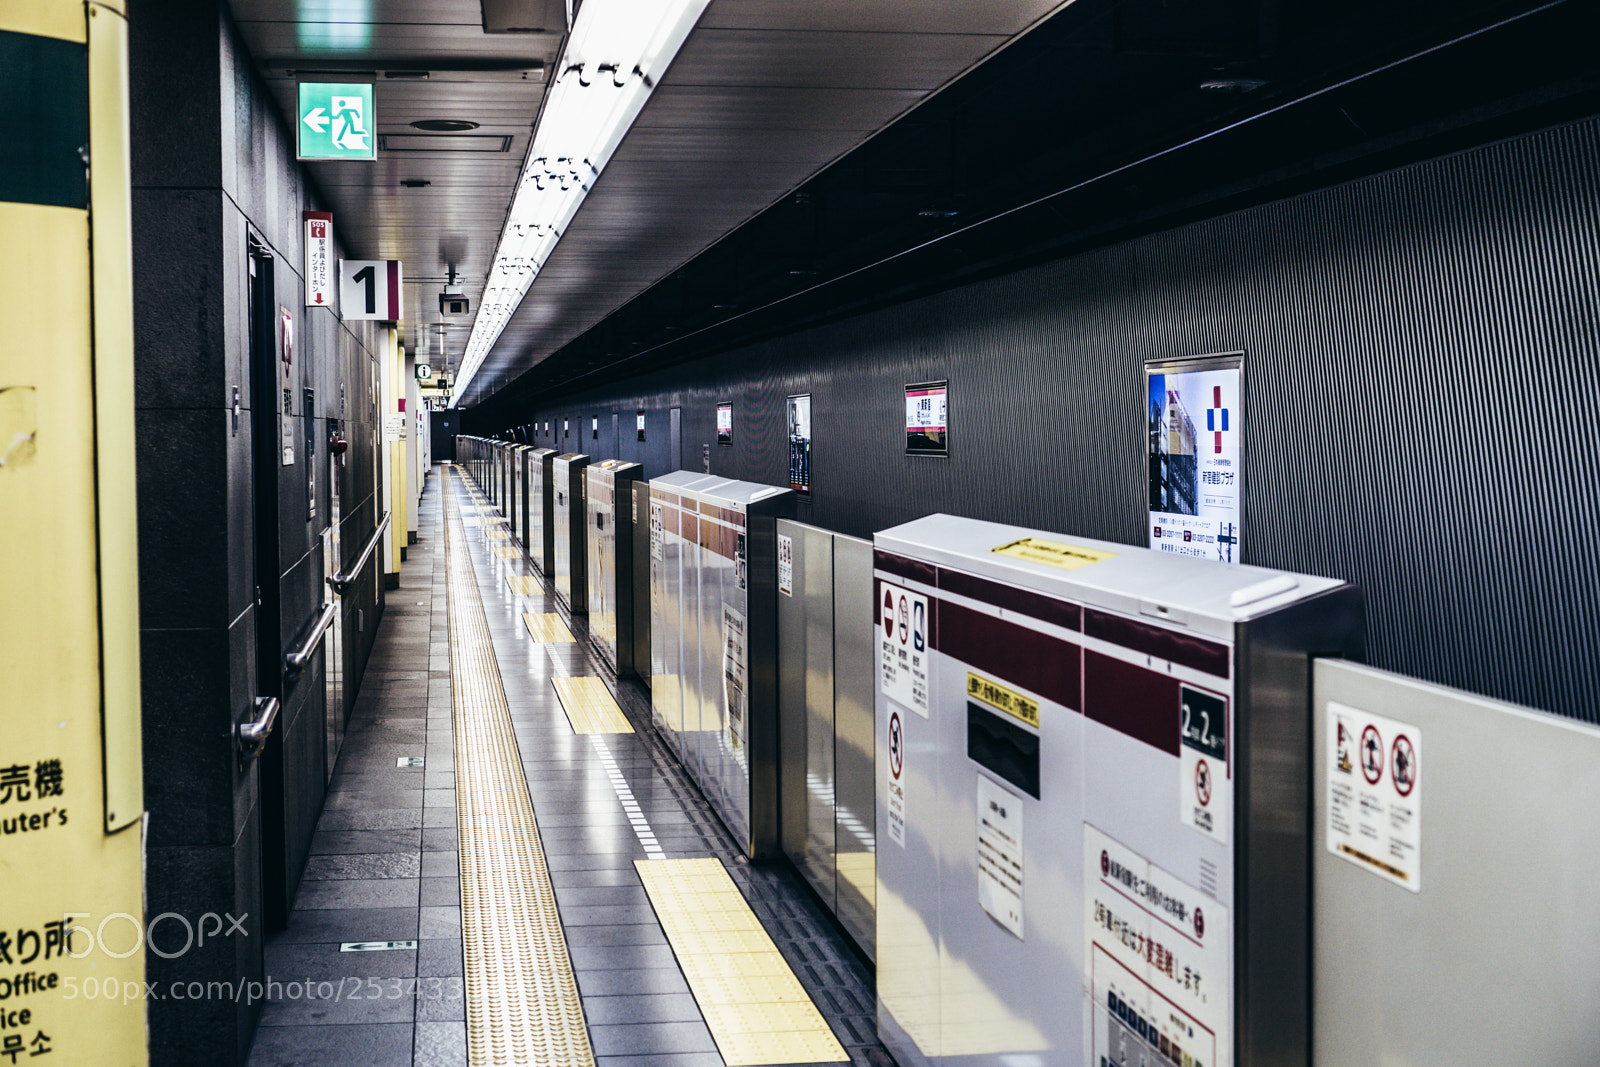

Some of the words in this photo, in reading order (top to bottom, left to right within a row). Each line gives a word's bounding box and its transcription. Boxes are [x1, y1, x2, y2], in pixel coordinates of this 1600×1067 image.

[352, 266, 376, 314] 1
[0, 807, 68, 835] uter's
[0, 1030, 52, 1065] 무소
